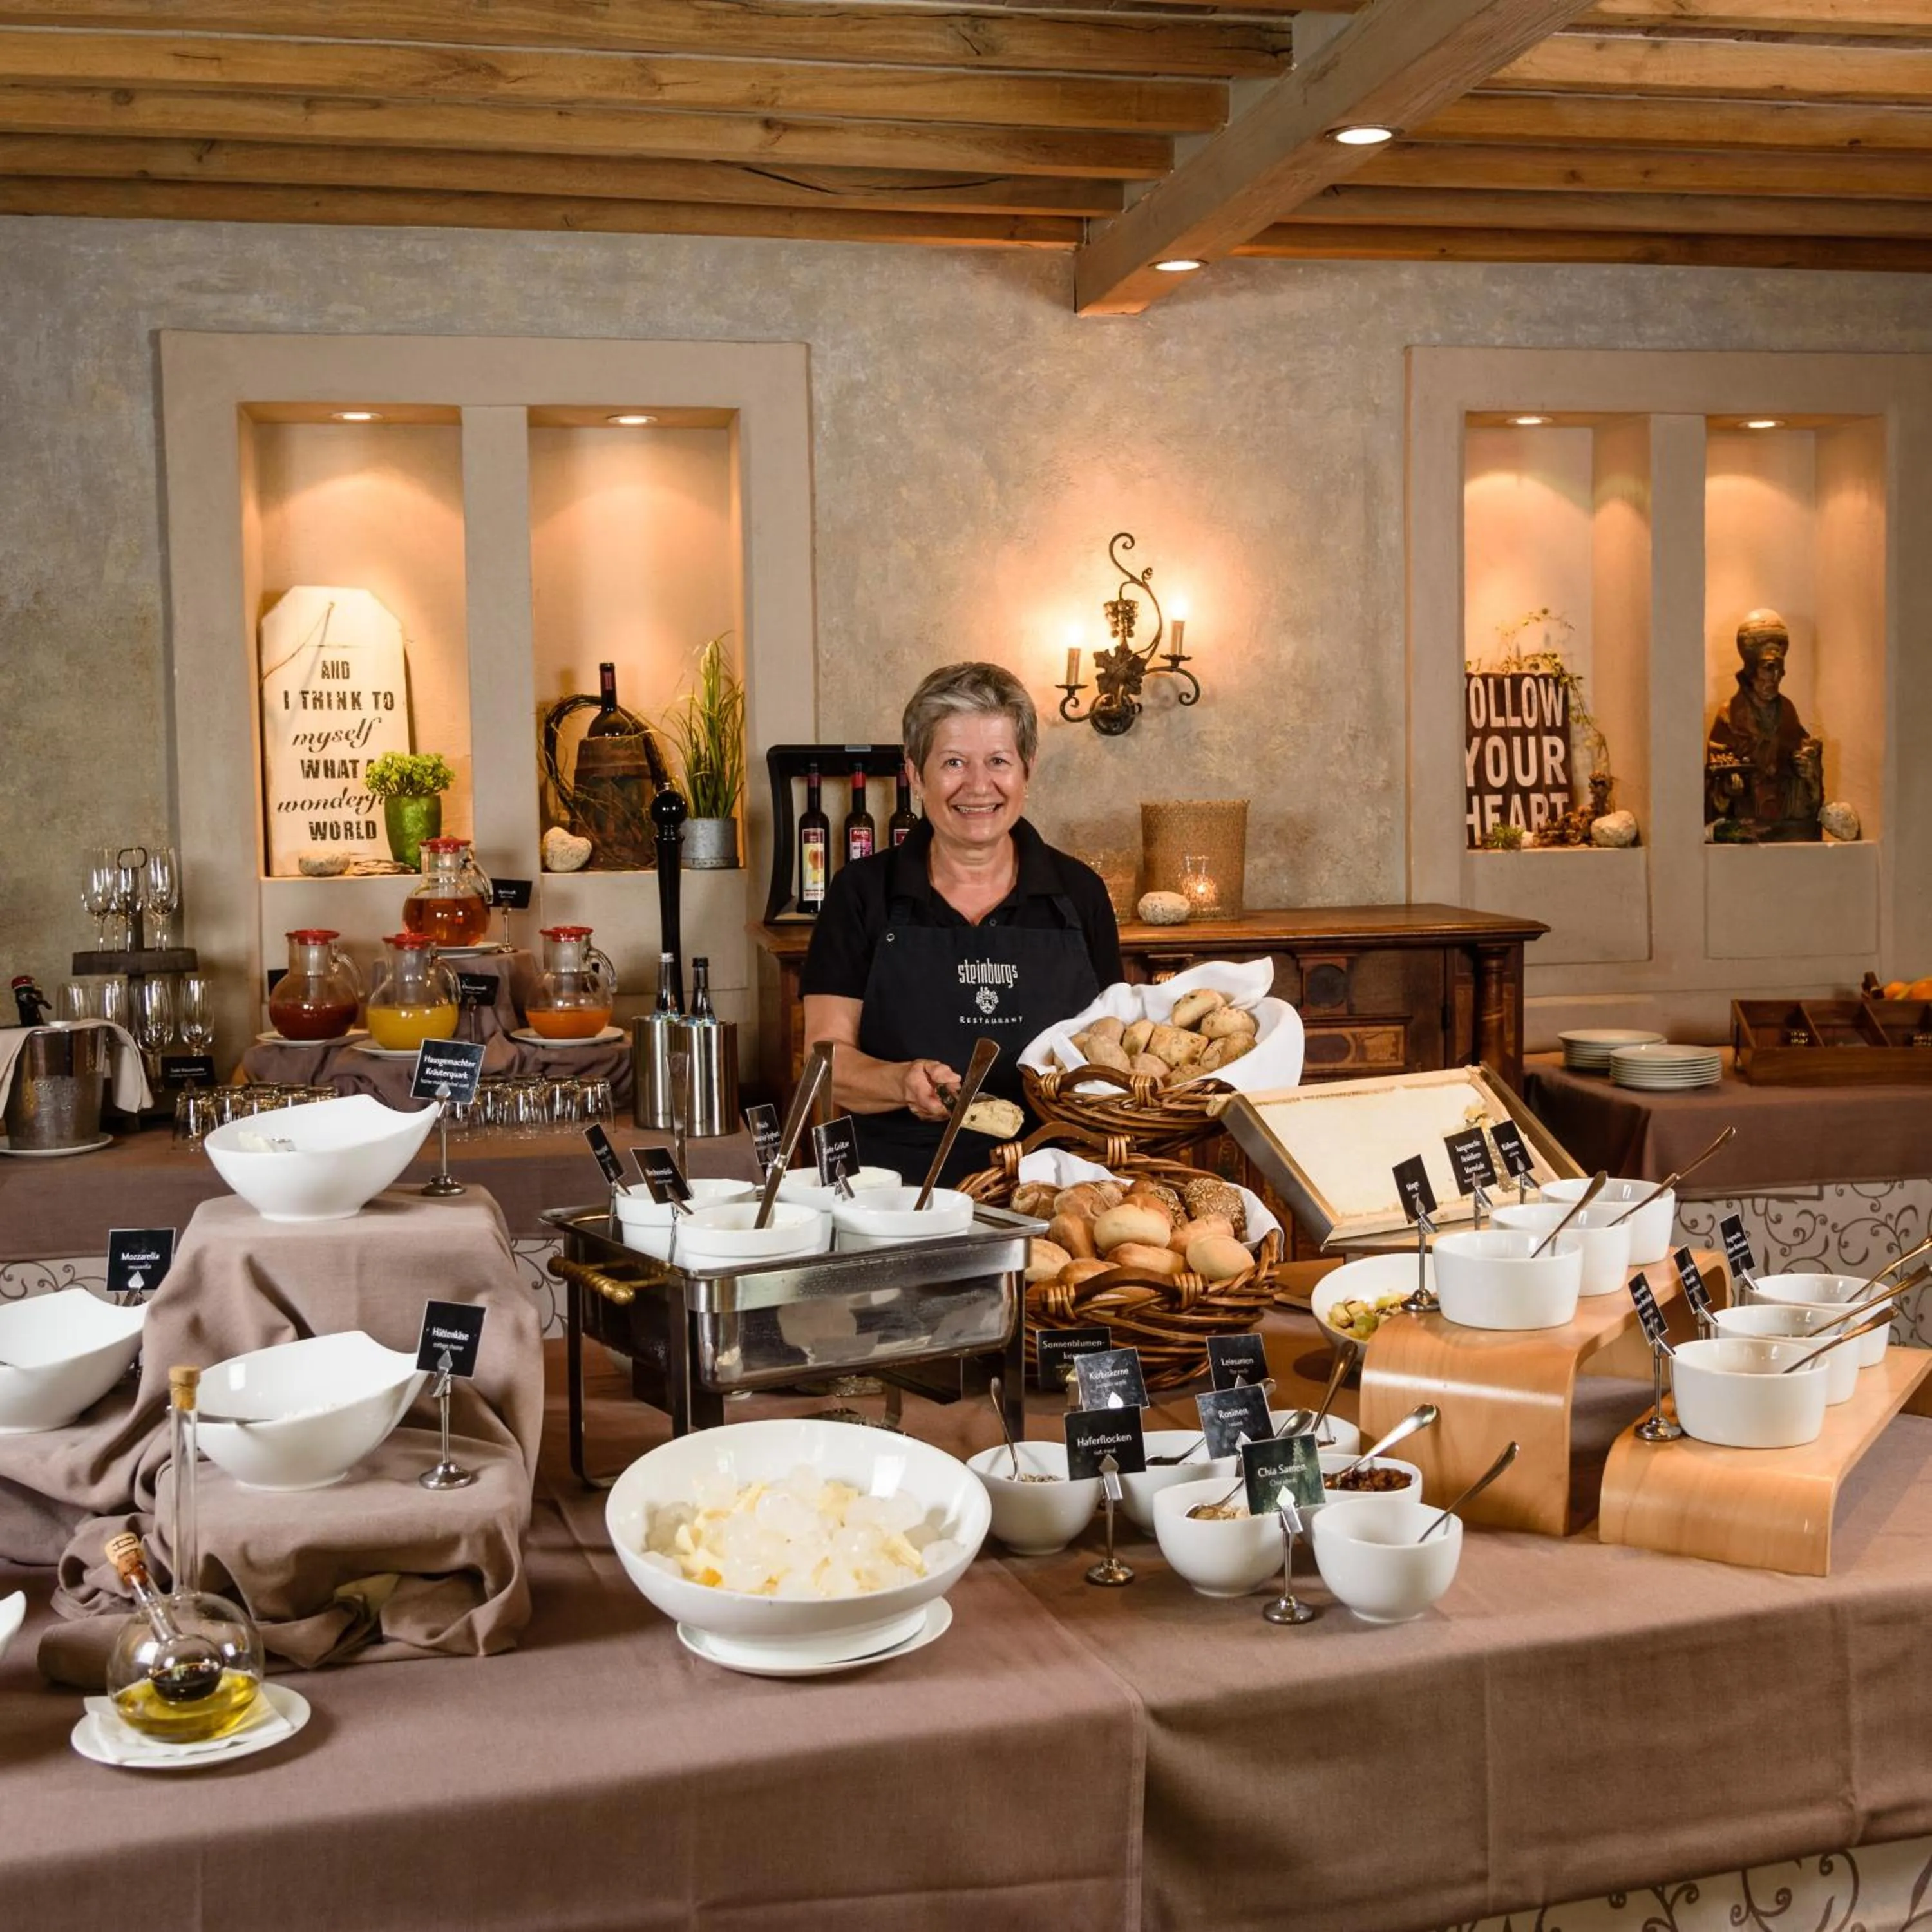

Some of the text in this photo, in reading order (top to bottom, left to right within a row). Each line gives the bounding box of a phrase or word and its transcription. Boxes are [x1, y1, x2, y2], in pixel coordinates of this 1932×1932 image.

[321, 660, 350, 679] AND
[283, 690, 394, 711] I THINK TO
[1466, 676, 1564, 729] OLLOW
[292, 717, 382, 753] myself
[301, 759, 359, 779] WHAT
[1466, 735, 1567, 788] YOUR
[278, 786, 384, 815] wonderf
[309, 820, 377, 840] WORLD
[958, 958, 1018, 989] steinburgs
[121, 1251, 160, 1260] Mozzarella
[1077, 1433, 1132, 1448] Haferflocken
[1258, 1466, 1277, 1477] Chia
